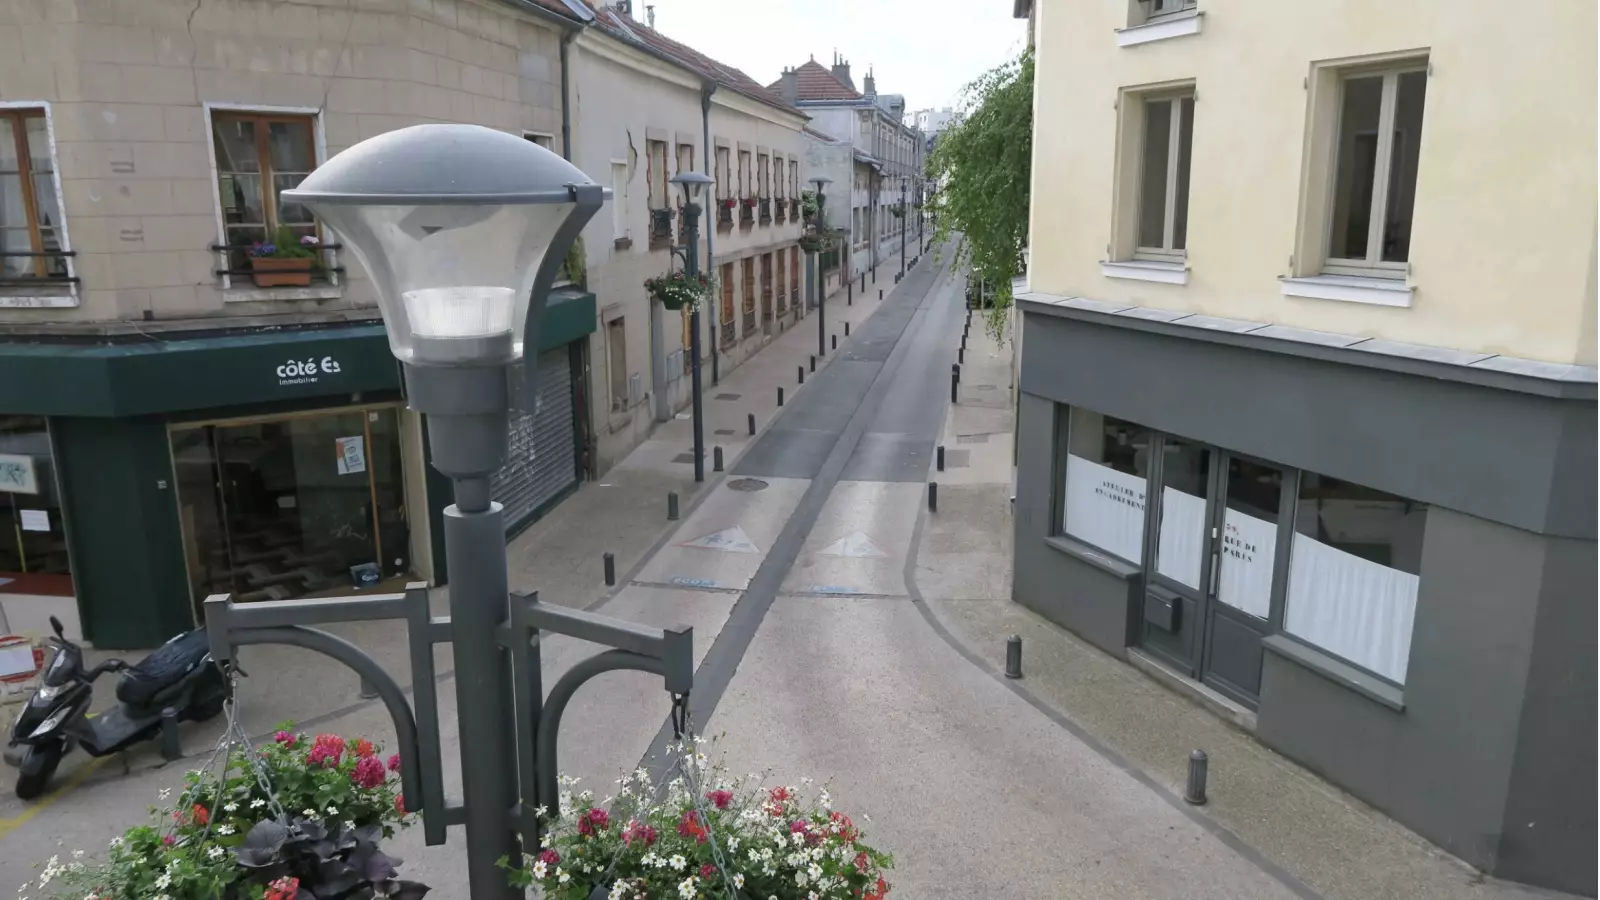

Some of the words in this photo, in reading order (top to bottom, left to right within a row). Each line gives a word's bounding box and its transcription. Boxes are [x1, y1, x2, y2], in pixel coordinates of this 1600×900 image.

[276, 357, 318, 378] côté
[1102, 480, 1134, 497] ATELIER
[1095, 487, 1145, 511] ENCADREMENT
[1224, 535, 1242, 548] RUE
[1245, 543, 1256, 553] DE
[1223, 546, 1253, 563] PARIS
